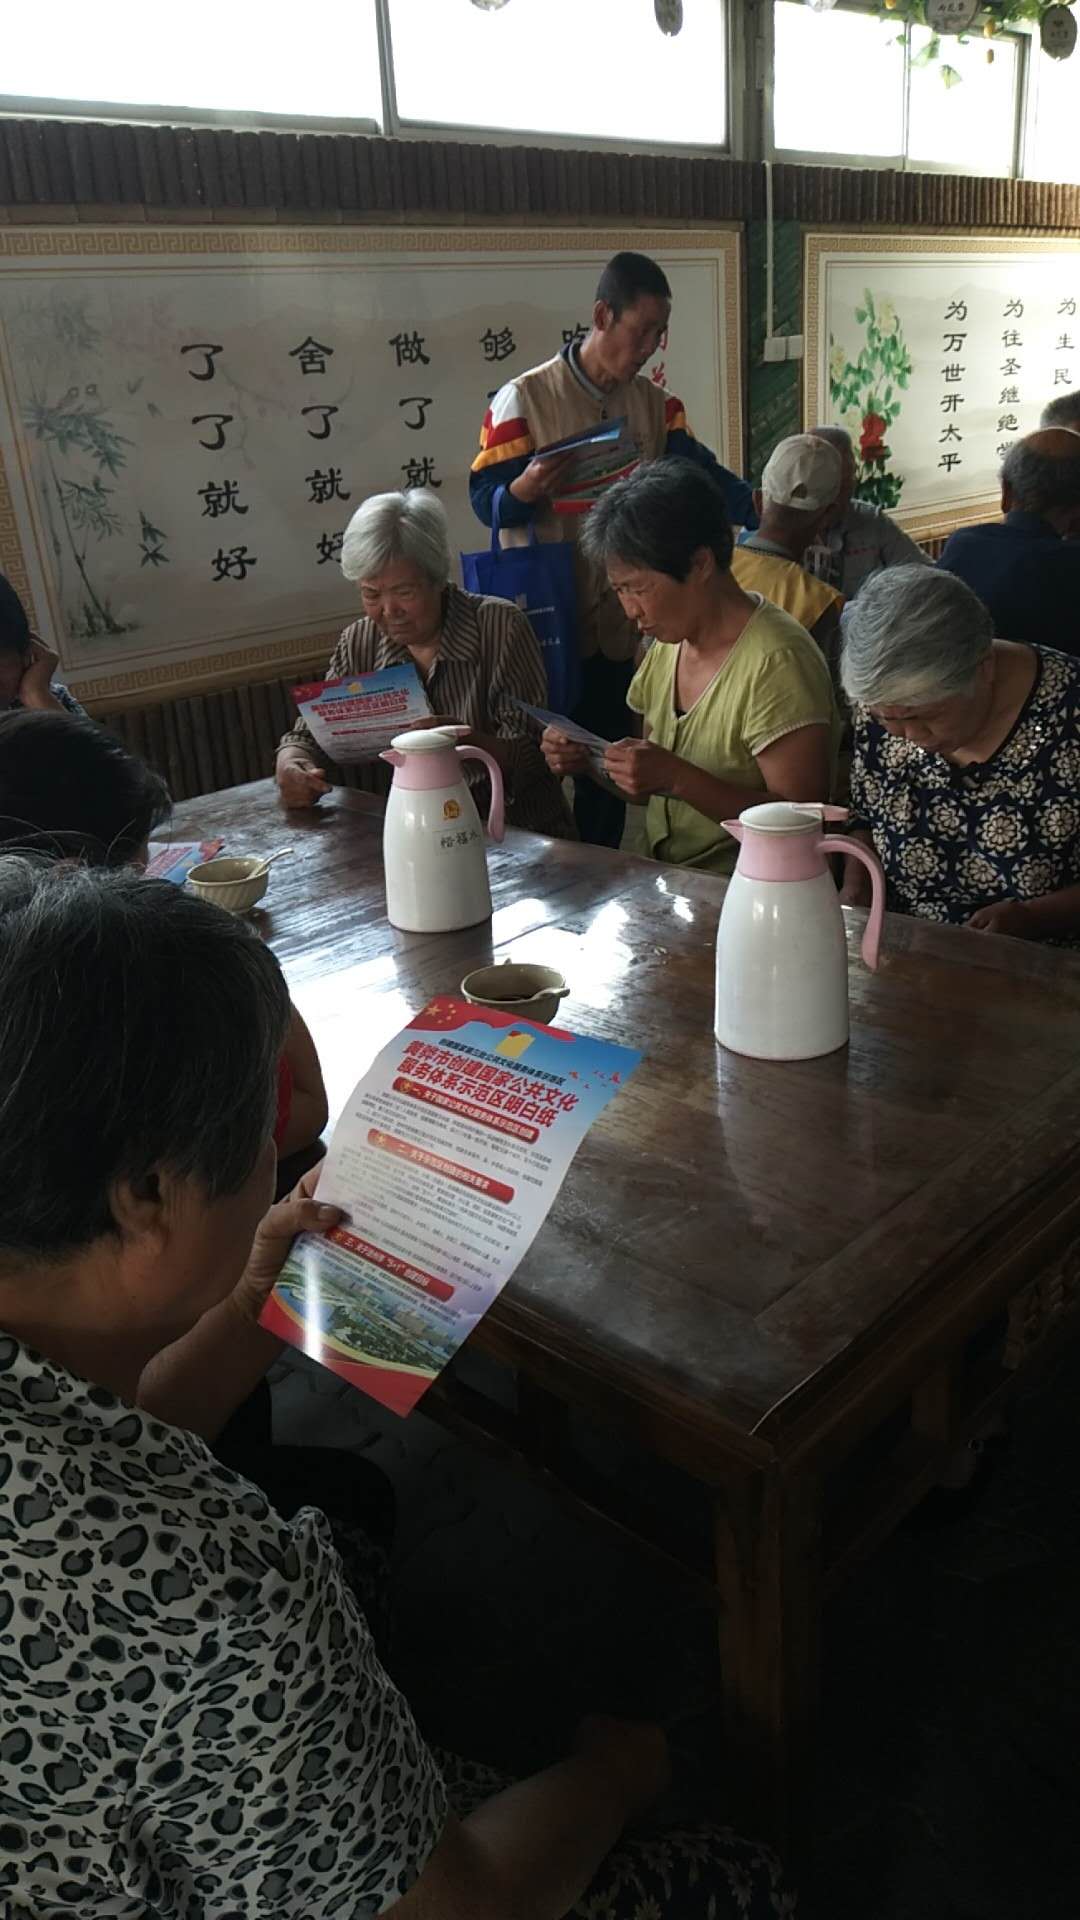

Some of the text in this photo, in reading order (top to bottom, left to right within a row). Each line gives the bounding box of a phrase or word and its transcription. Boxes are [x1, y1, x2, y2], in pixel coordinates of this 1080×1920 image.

[180, 344, 258, 582] 了了就好
[389, 330, 442, 489] 做了就
[937, 300, 968, 473] 为万世开太平
[397, 1056, 559, 1128] 服务体系示范区明白纸
[403, 1040, 580, 1112] 黄骅市创建国家公共文化
